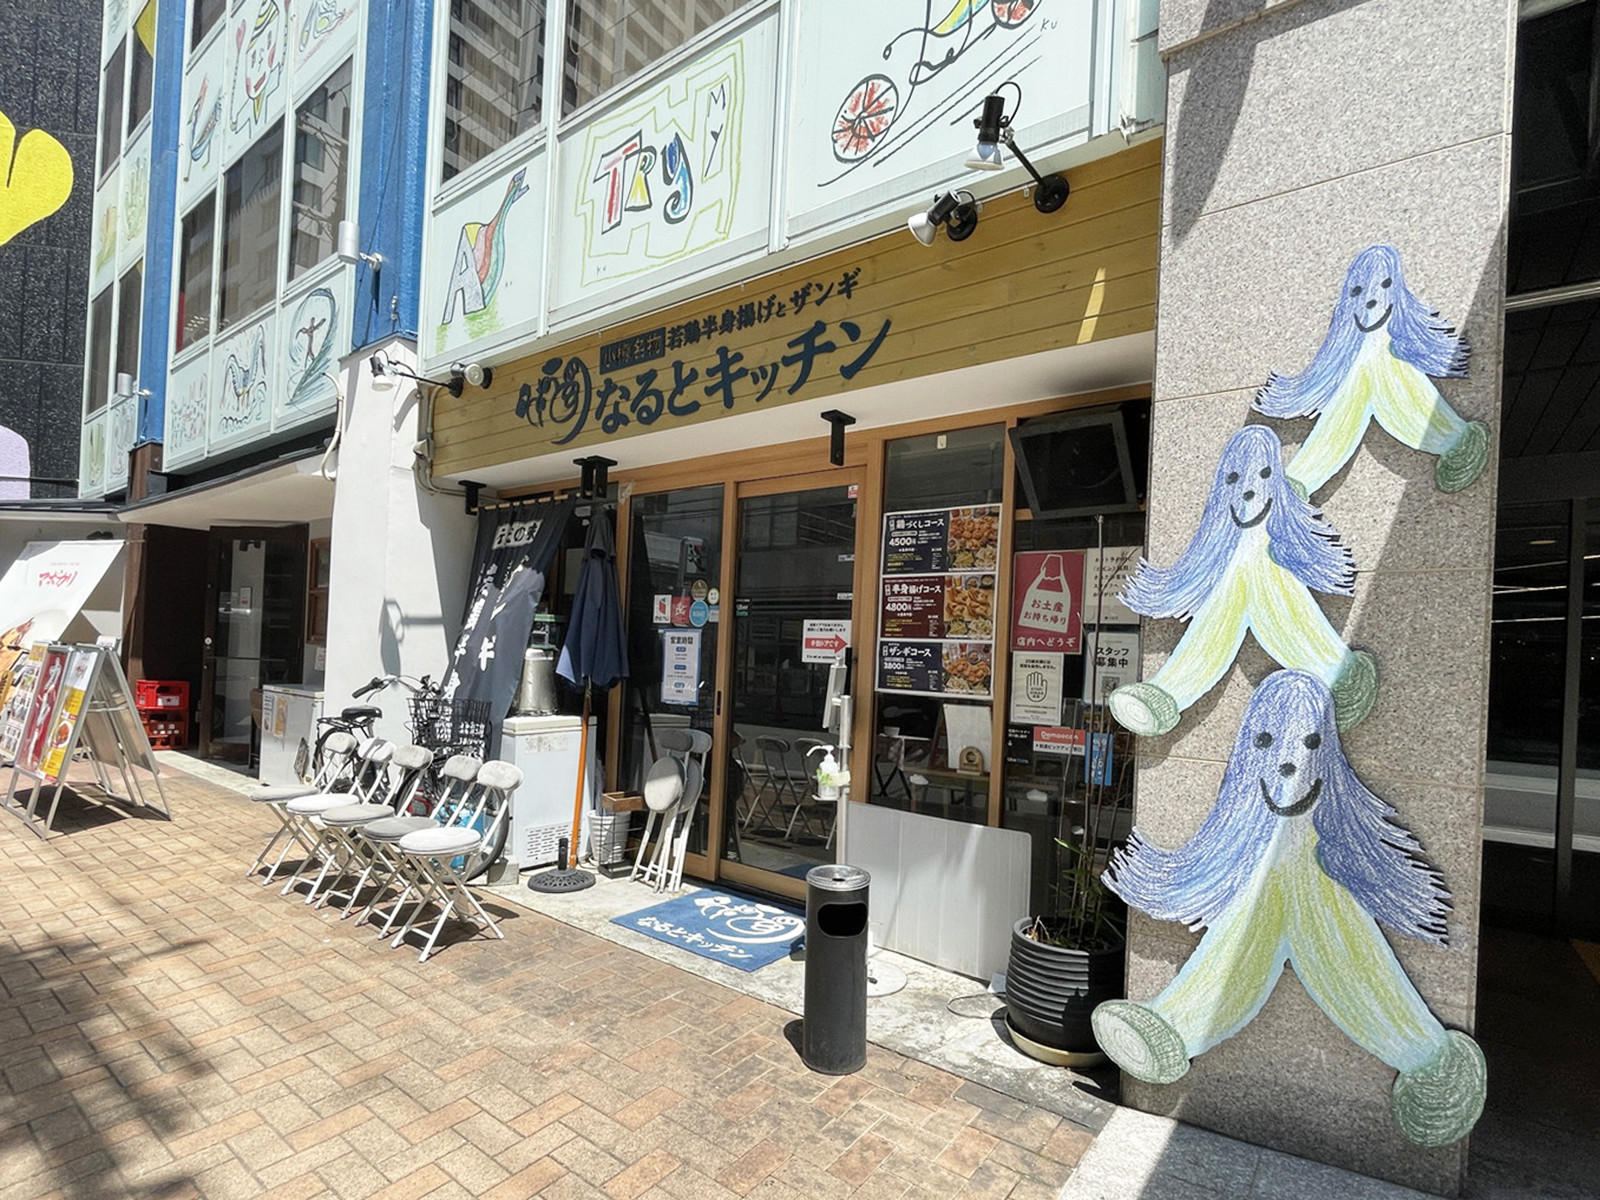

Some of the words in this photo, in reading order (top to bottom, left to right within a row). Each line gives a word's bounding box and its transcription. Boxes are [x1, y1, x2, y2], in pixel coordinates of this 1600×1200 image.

[667, 267, 862, 351] 若鶏半身揚げとザンギ
[595, 318, 893, 435] なるとキッチン
[1031, 598, 1064, 613] お土産
[1023, 611, 1067, 625] お持ち帰り
[670, 636, 694, 645] 営業時間
[1016, 637, 1077, 648] 店内へどうぞ
[889, 646, 932, 657] ザンギコース
[1097, 646, 1129, 656] スタッフ
[1096, 657, 1129, 668] 募集中
[636, 916, 753, 959] なるとキッチン
